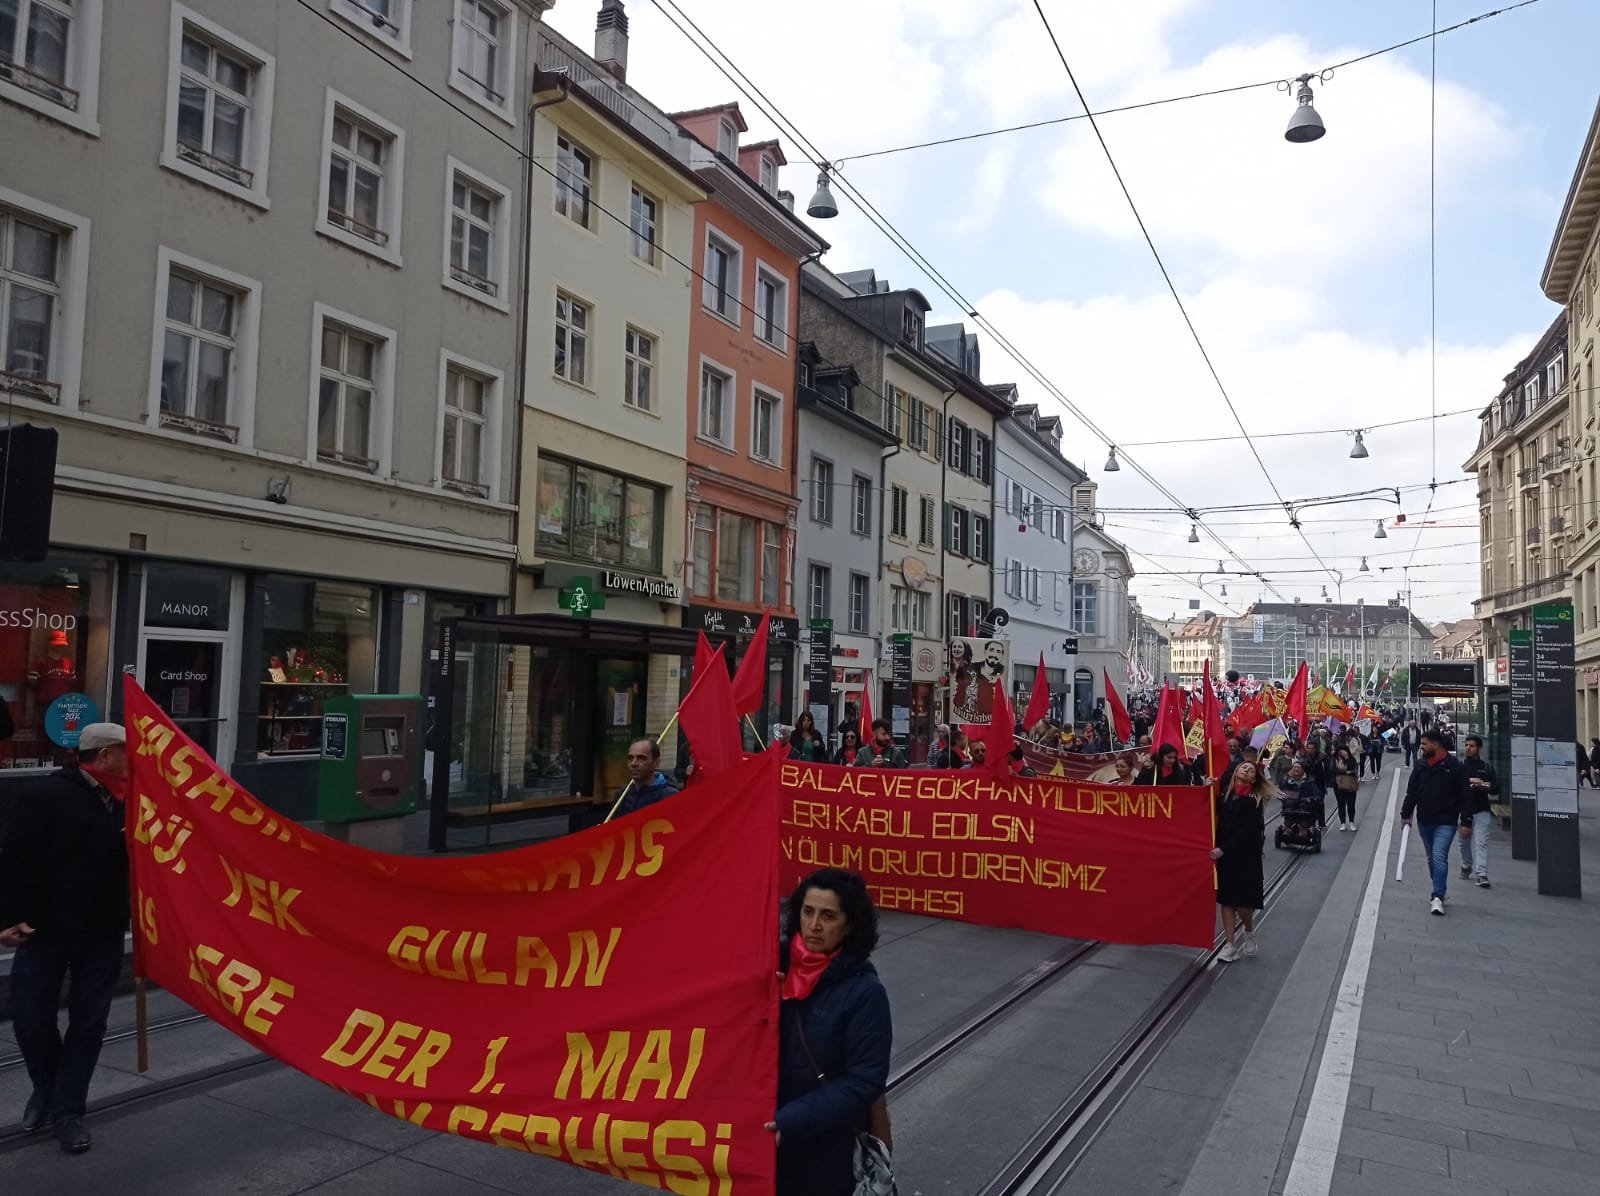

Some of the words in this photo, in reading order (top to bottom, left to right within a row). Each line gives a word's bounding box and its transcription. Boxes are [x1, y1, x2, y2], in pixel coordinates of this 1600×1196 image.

[161, 602, 208, 616] MANOR
[442, 626, 450, 676] Rheingasse
[160, 670, 183, 680] Card
[184, 671, 207, 683] Shop
[781, 764, 877, 797] BALAÇ
[882, 775, 914, 798] VE
[835, 804, 925, 839] KABUL
[869, 847, 956, 879] ORUCU
[321, 1007, 452, 1087] DER
[554, 1027, 706, 1101] MAI
